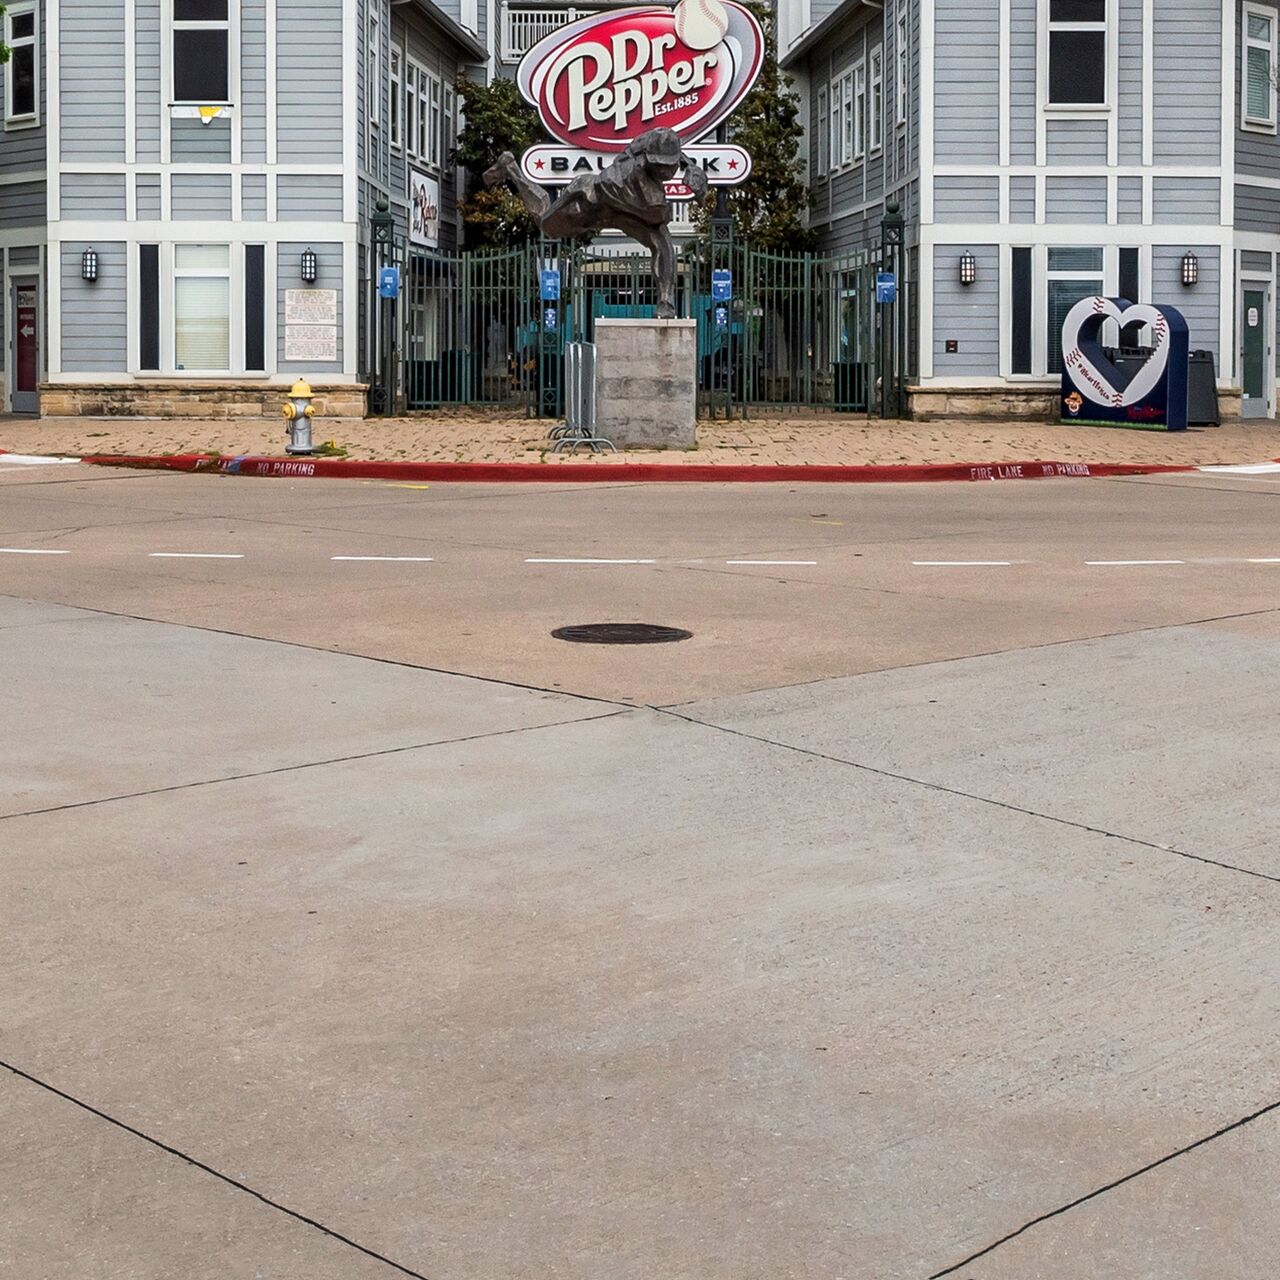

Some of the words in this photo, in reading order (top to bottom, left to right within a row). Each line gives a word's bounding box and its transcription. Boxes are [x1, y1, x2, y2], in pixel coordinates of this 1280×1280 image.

[610, 30, 676, 83] Dr
[546, 42, 718, 131] Pepper
[257, 463, 269, 472] NO
[273, 463, 315, 475] PARKING
[971, 467, 993, 479] FIRE
[998, 466, 1024, 478] LANE
[1042, 465, 1054, 475] NO
[1056, 464, 1090, 475] PARKING
